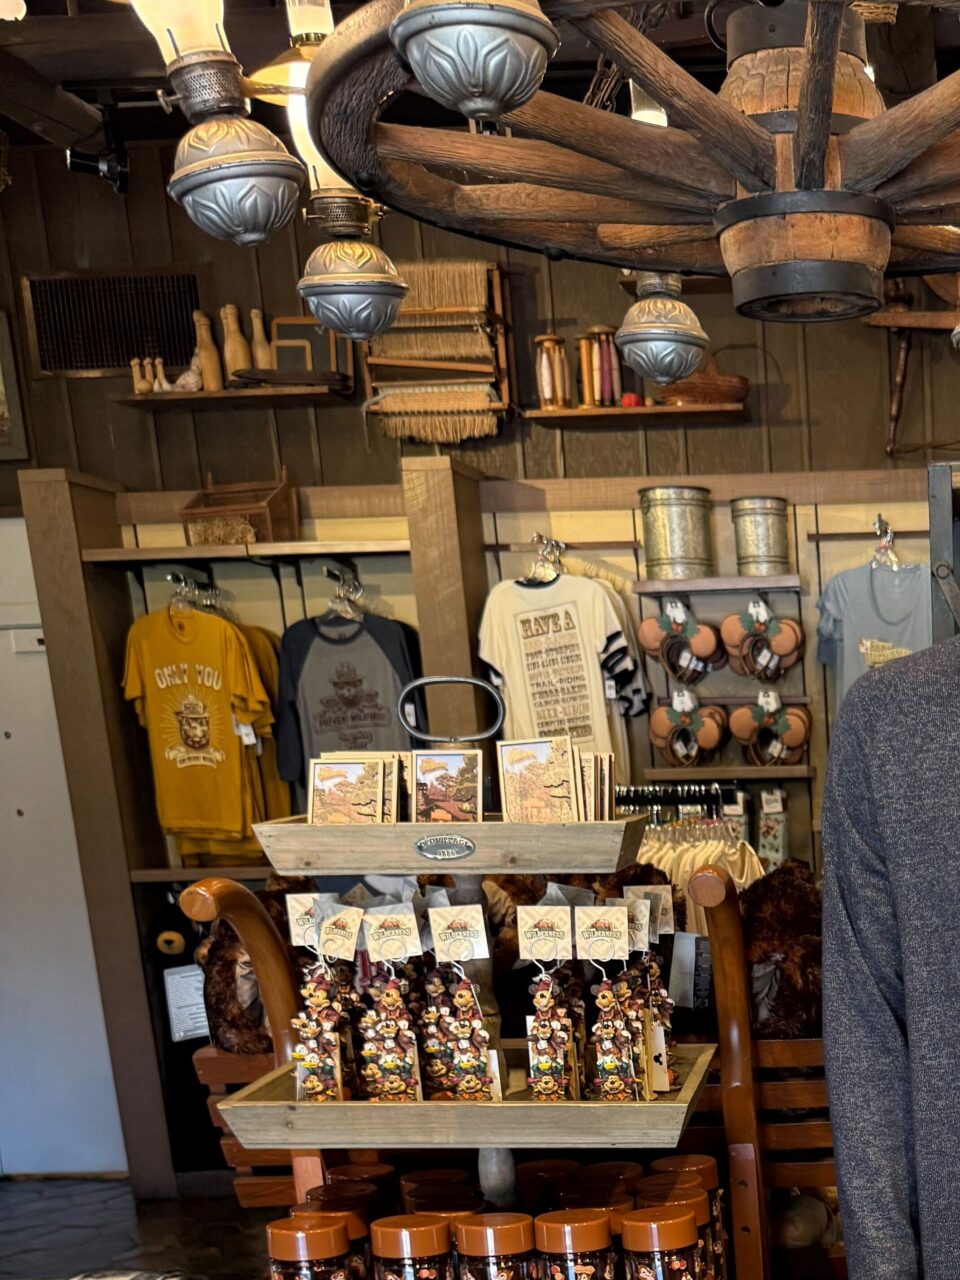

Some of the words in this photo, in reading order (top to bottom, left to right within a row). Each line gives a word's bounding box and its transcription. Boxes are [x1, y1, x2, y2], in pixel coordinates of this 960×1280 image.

[519, 612, 562, 640] HAVE
[564, 609, 576, 631] A
[154, 662, 188, 690] ONLY
[195, 663, 223, 691] YOU
[530, 675, 586, 689] TRAIL-RIDING
[370, 927, 412, 942] WILDERNESS
[438, 929, 480, 942] WILDERNESS
[523, 930, 566, 940] WILDERNESS
[581, 930, 623, 940] WILDERNESS
